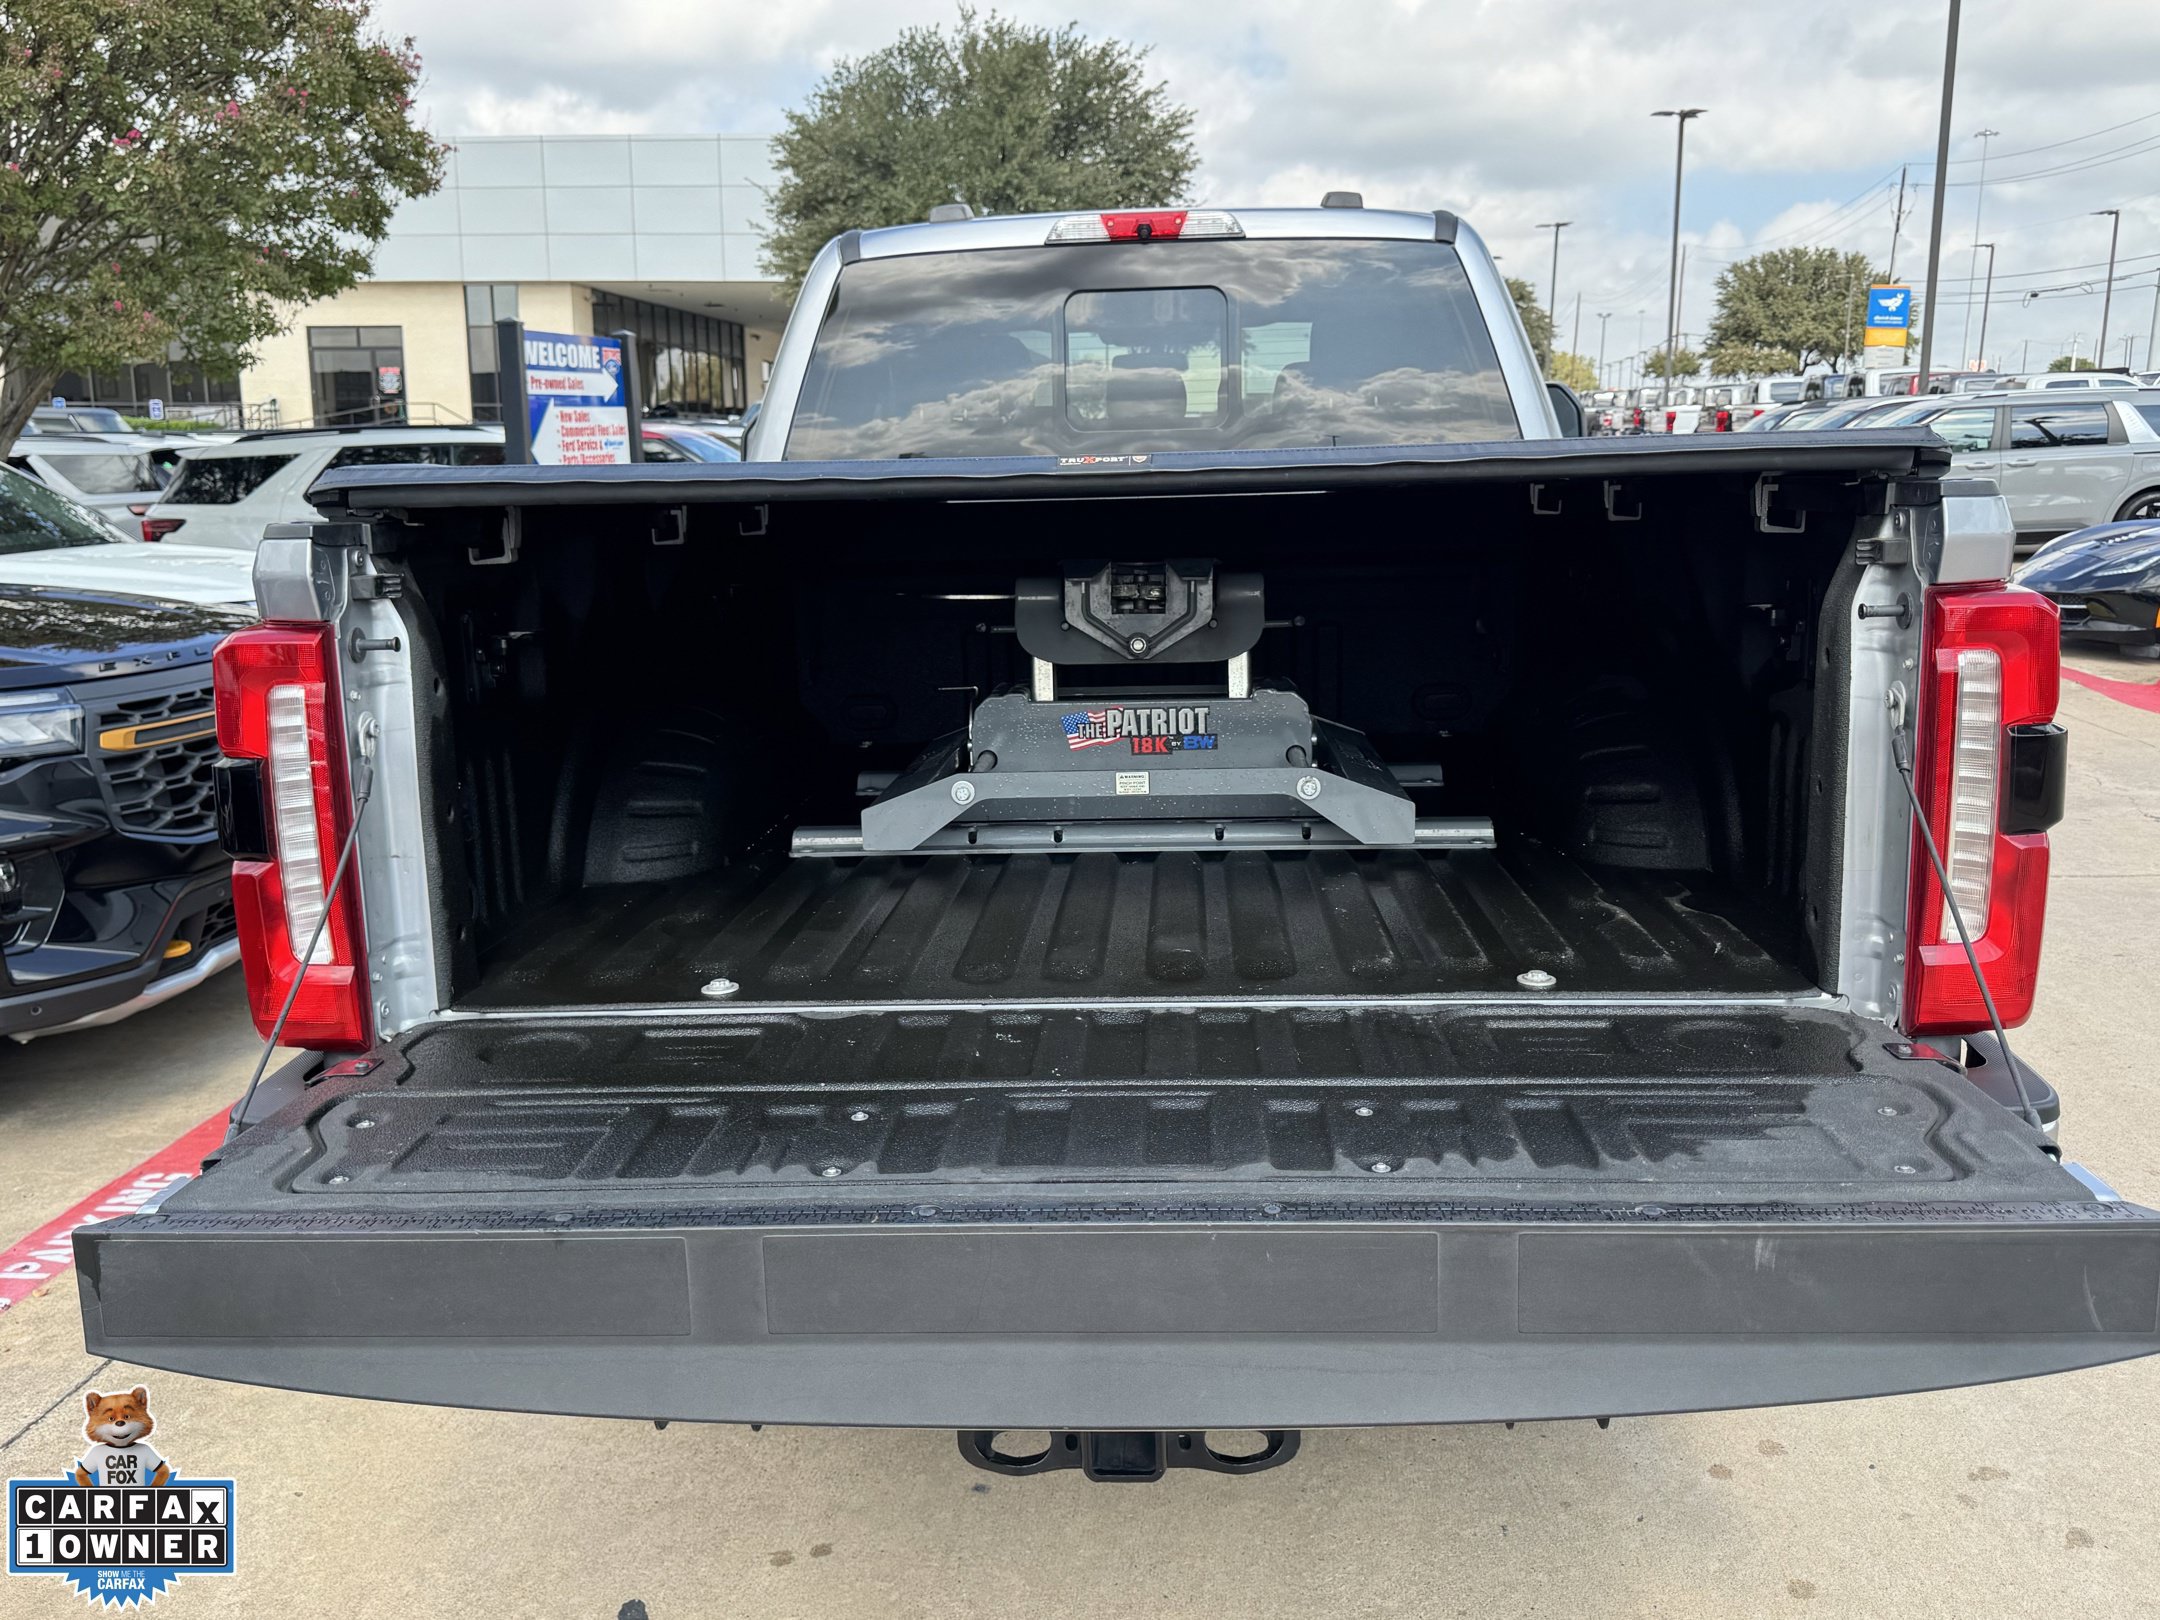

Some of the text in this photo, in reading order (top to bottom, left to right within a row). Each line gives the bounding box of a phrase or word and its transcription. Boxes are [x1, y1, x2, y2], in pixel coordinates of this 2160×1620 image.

[524, 340, 601, 370] WELCOME
[530, 375, 585, 391] Pre-owned Sales
[559, 410, 590, 423] New Sales
[1077, 707, 1209, 739] THE PATRIOT
